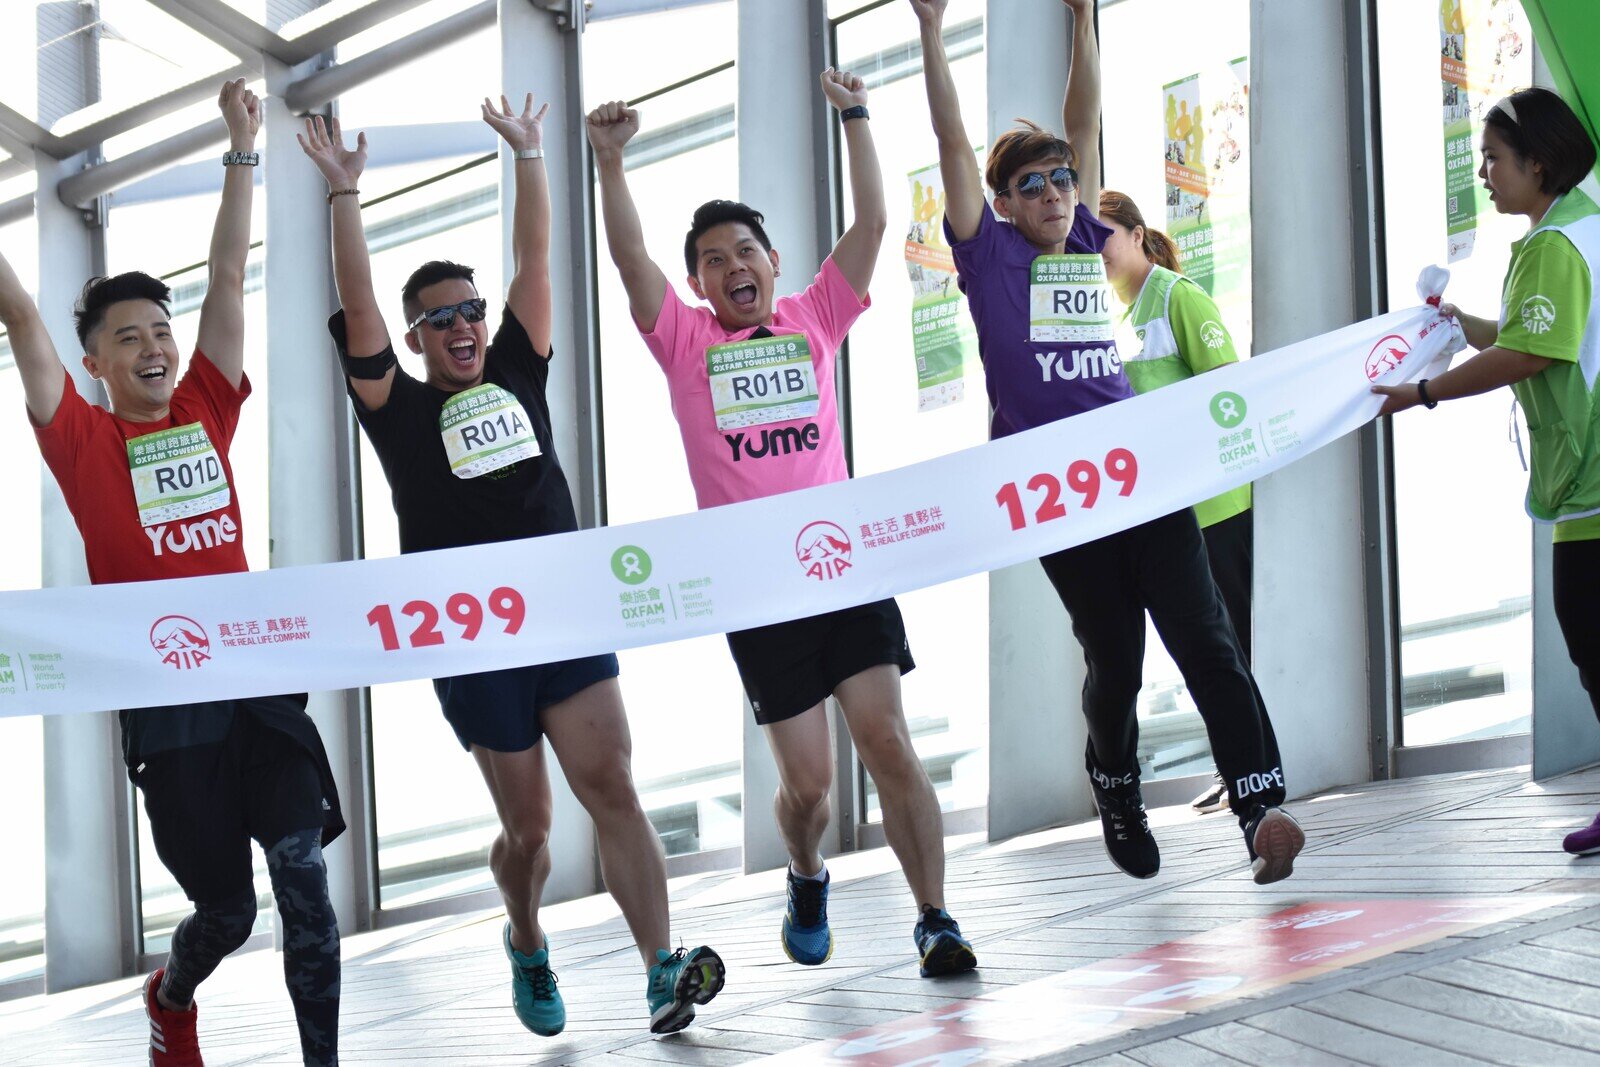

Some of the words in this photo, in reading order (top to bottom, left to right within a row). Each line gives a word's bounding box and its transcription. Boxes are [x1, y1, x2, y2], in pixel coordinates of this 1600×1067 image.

[1447, 155, 1472, 170] OXFAM
[712, 344, 786, 364] 樂施競跑旅遊塔
[713, 362, 743, 372] OXFAM
[745, 356, 787, 367] TOWERRUN
[1036, 346, 1121, 382] Yume
[732, 369, 804, 401] R01B
[444, 414, 469, 427] OXFAM
[460, 412, 526, 450] R01A
[1218, 428, 1253, 450] 樂施會
[725, 423, 819, 462] Yume
[135, 453, 166, 465] OXFAM
[1219, 443, 1257, 465] OXFAM
[155, 456, 220, 494] R01D
[1224, 462, 1242, 474] Hong
[1242, 457, 1260, 470] Kong
[995, 447, 1139, 531] 1299
[859, 517, 898, 540] 真生活
[903, 506, 942, 529] 真夥伴
[145, 513, 237, 556] Yume
[863, 540, 877, 549] THE
[878, 536, 895, 546] REAL
[897, 532, 911, 542] LIFE
[911, 522, 945, 538] COMPANY
[806, 557, 853, 581] AIA
[619, 586, 661, 605] 樂施會
[681, 592, 703, 602] World
[682, 599, 713, 610] Without
[366, 586, 526, 652] 1299
[621, 603, 665, 620] OXFAM
[685, 608, 713, 619] Poverty
[217, 620, 261, 638] 真生活
[265, 616, 308, 634] 真夥伴
[625, 618, 645, 629] Hong
[646, 615, 665, 628] Kong
[222, 638, 236, 648] THE
[237, 636, 256, 646] REAL
[257, 634, 273, 644] LIFE
[274, 630, 311, 643] COMPANY
[32, 664, 54, 672] World
[162, 649, 212, 670] AIA
[35, 672, 66, 681] Without
[36, 681, 66, 691] Poverty
[1236, 767, 1284, 799] DOPE
